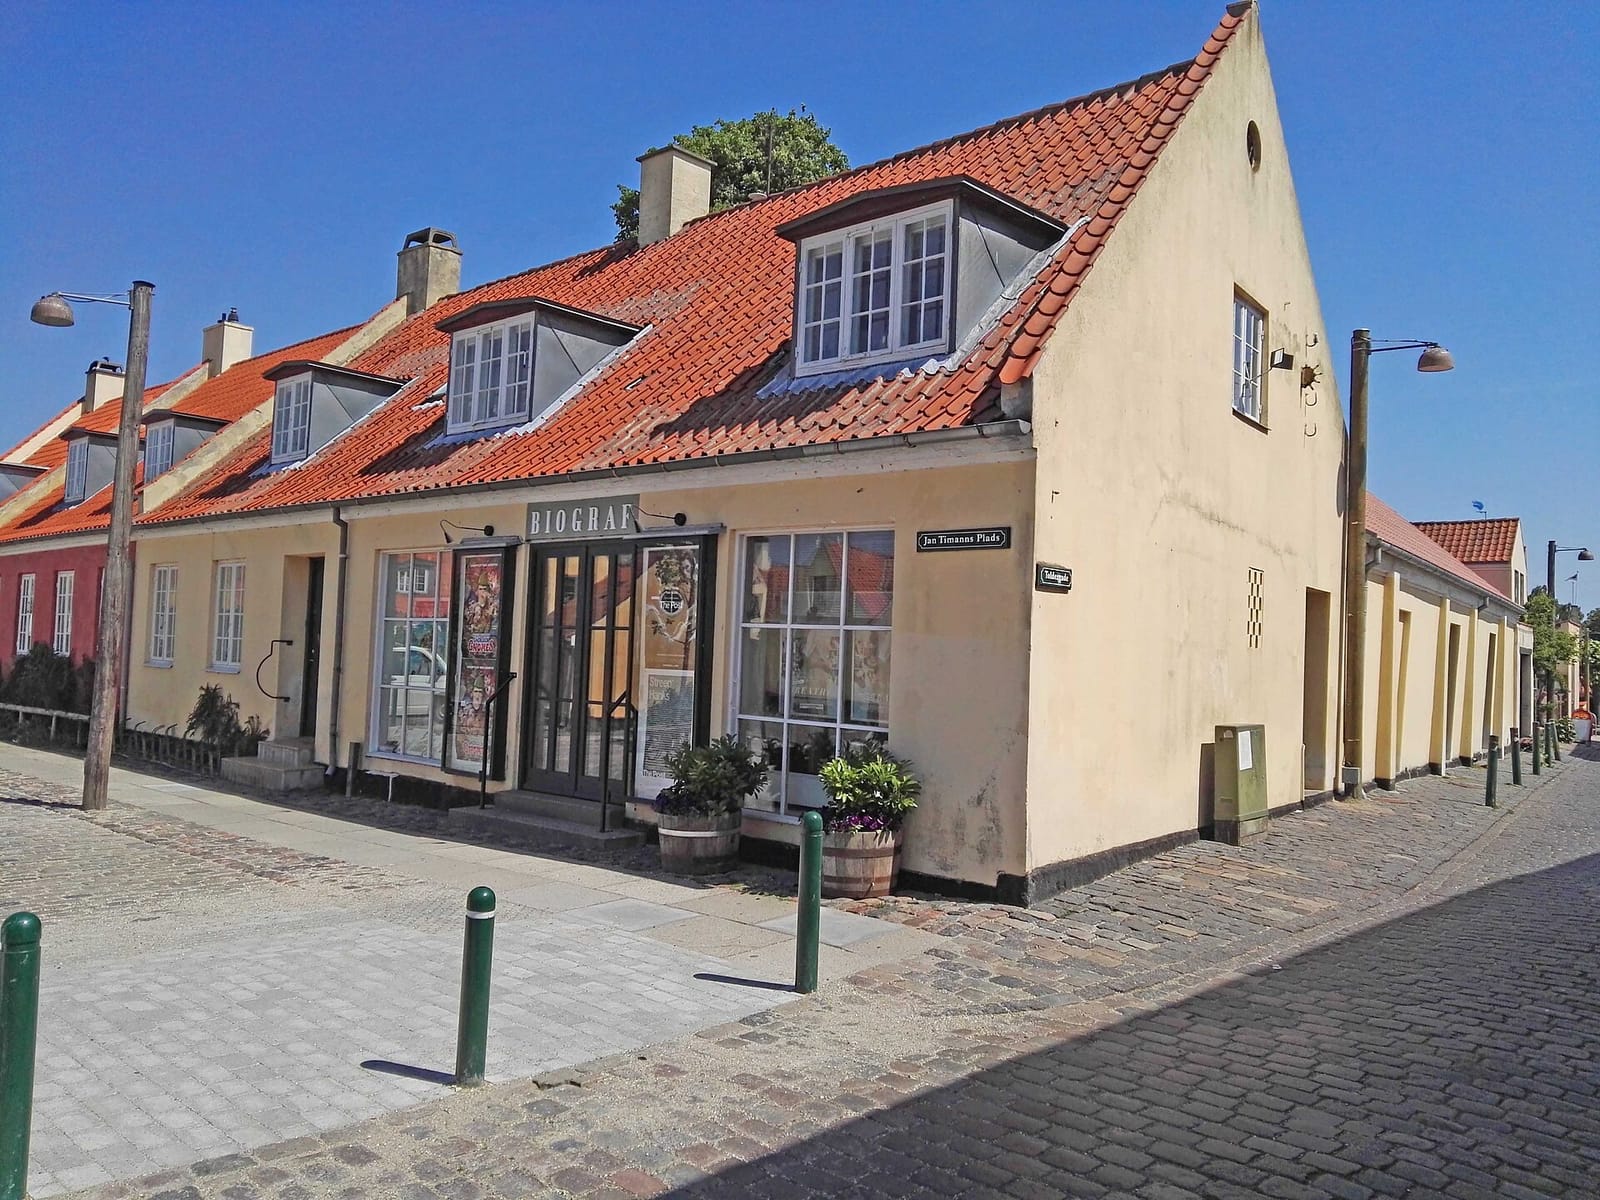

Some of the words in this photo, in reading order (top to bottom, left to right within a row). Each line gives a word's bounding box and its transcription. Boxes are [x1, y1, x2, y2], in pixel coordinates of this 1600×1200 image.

[531, 503, 633, 535] BIOGRAF
[923, 536, 937, 546] Jan
[938, 535, 974, 544] Timanns
[976, 533, 1001, 543] Plads
